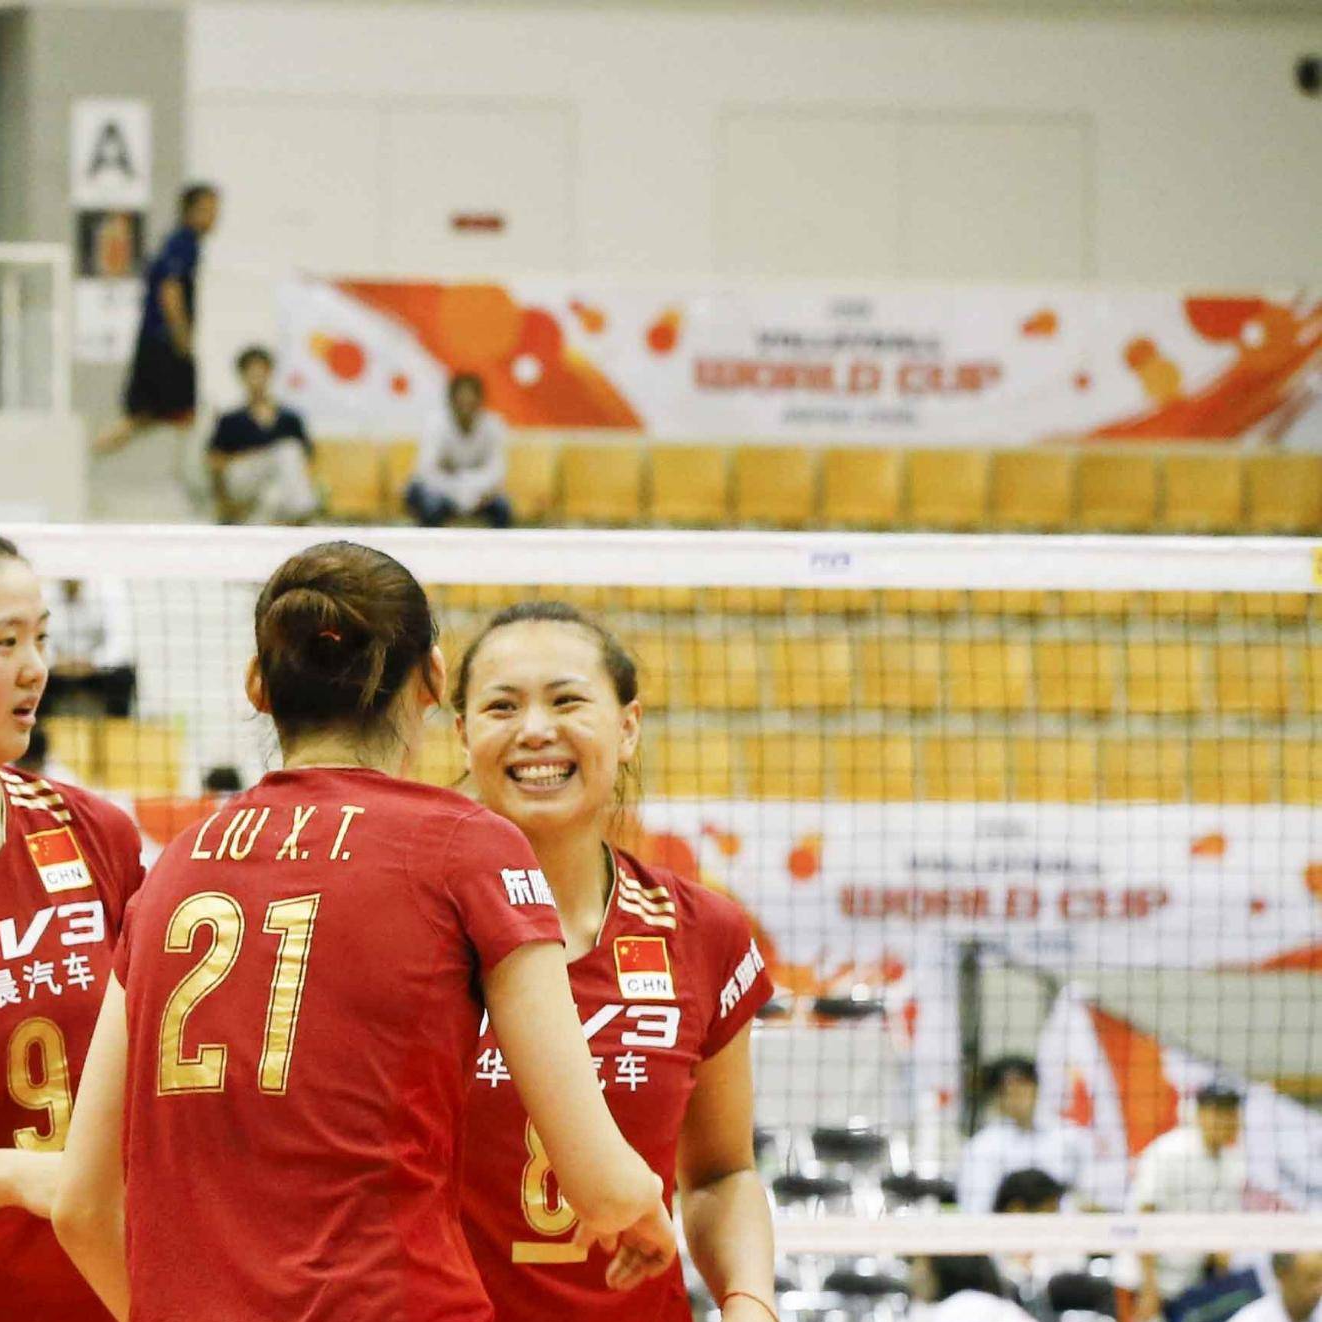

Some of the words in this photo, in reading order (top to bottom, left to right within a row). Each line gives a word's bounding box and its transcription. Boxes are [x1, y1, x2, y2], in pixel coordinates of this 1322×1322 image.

[190, 806, 269, 861] LIU
[45, 866, 84, 885] CHN
[157, 891, 322, 1096] 21
[626, 978, 668, 992] CHN
[8, 1017, 73, 1151] 9
